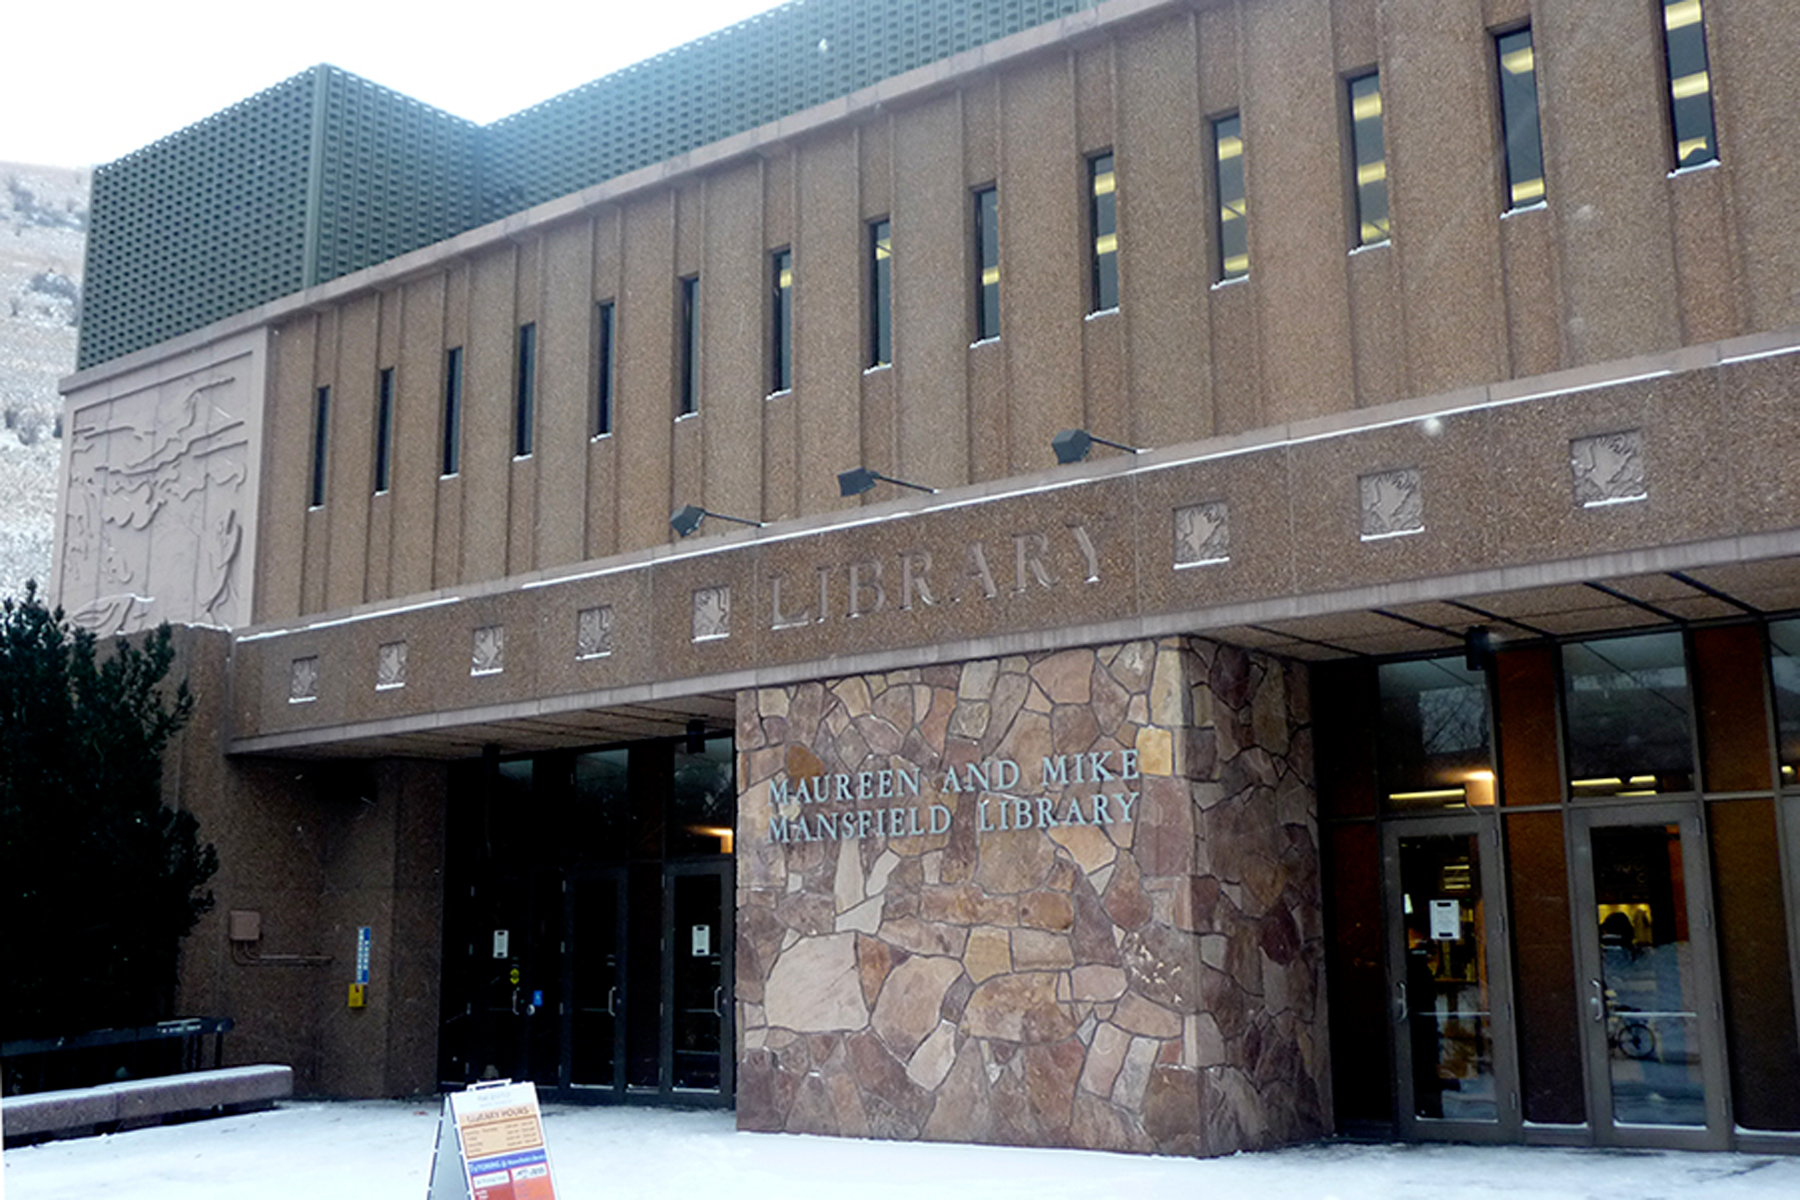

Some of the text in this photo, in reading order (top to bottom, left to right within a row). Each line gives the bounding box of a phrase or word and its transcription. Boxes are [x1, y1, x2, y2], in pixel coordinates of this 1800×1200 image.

[769, 516, 1112, 631] LIBRARY
[767, 749, 1140, 806] MAUREEN AND MIKE
[767, 792, 1140, 844] MANSFIELD LIBRARY
